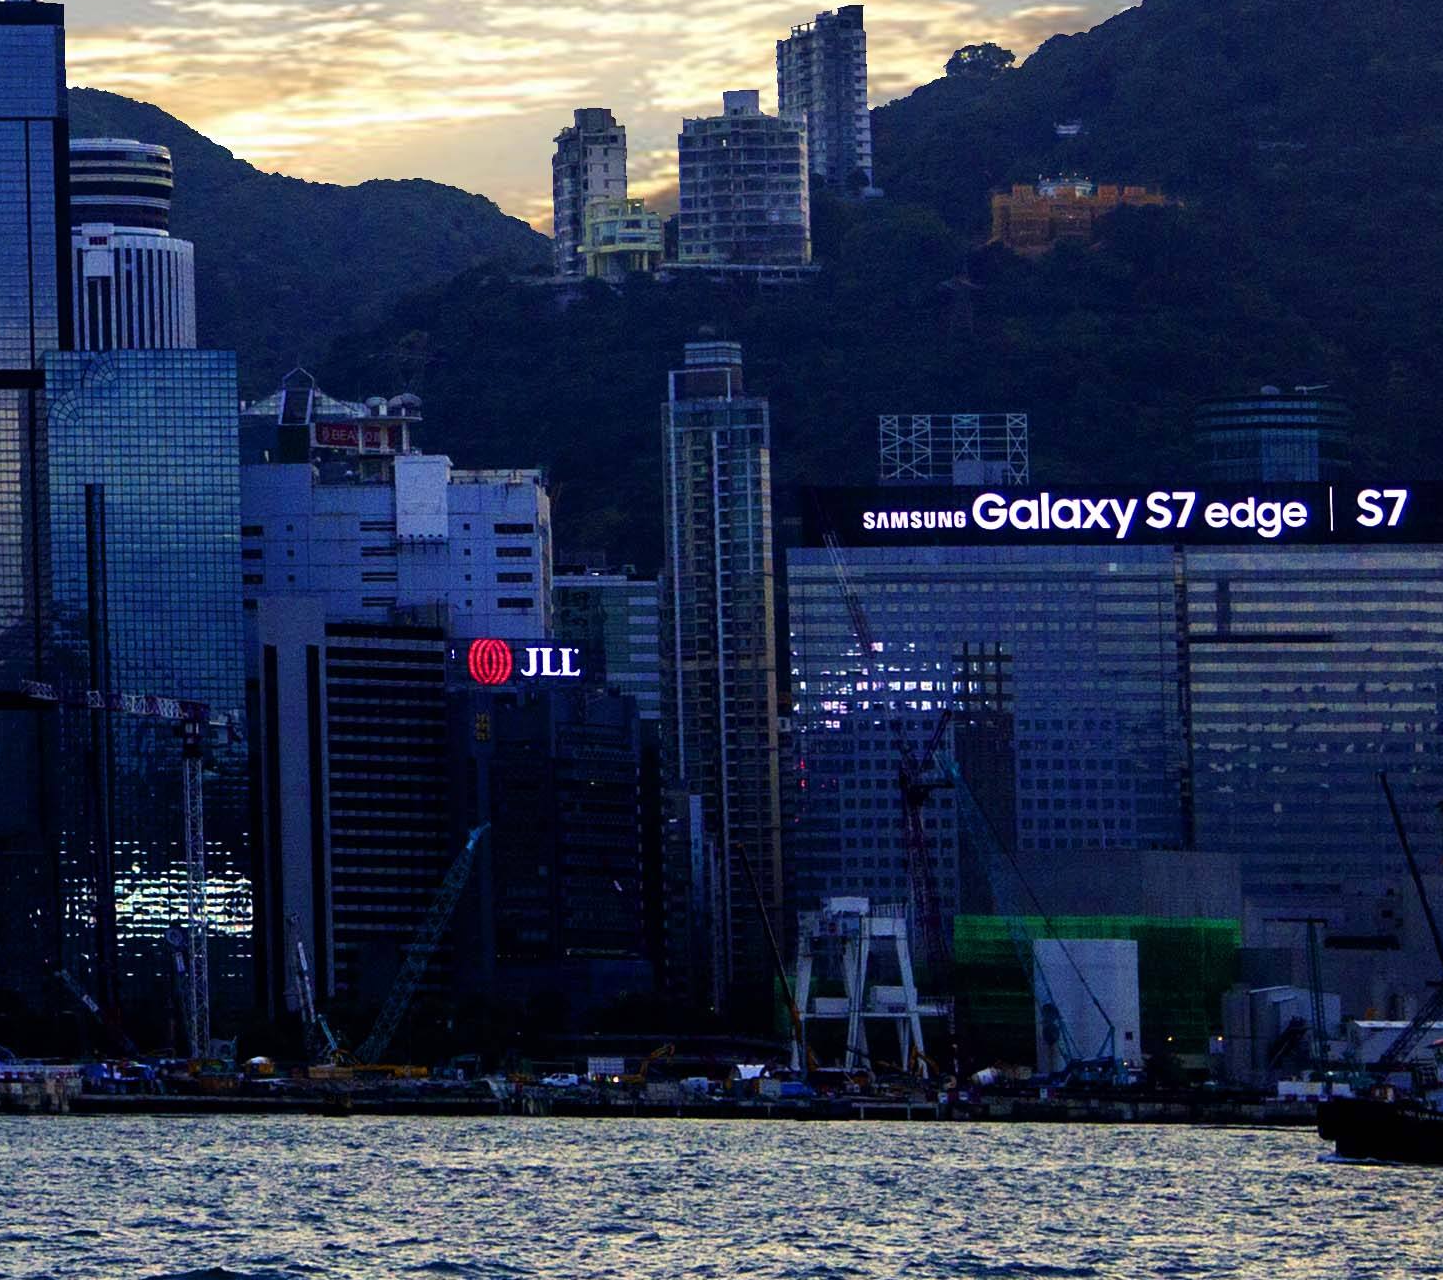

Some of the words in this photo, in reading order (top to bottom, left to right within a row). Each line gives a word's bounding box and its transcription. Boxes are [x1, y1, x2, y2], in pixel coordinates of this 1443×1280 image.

[863, 511, 966, 530] SAMSUNG
[972, 492, 1138, 539] Galaxy
[1146, 491, 1196, 530] S7
[1204, 496, 1307, 538] edge
[1356, 489, 1407, 527] S7
[520, 647, 581, 677] JLL
